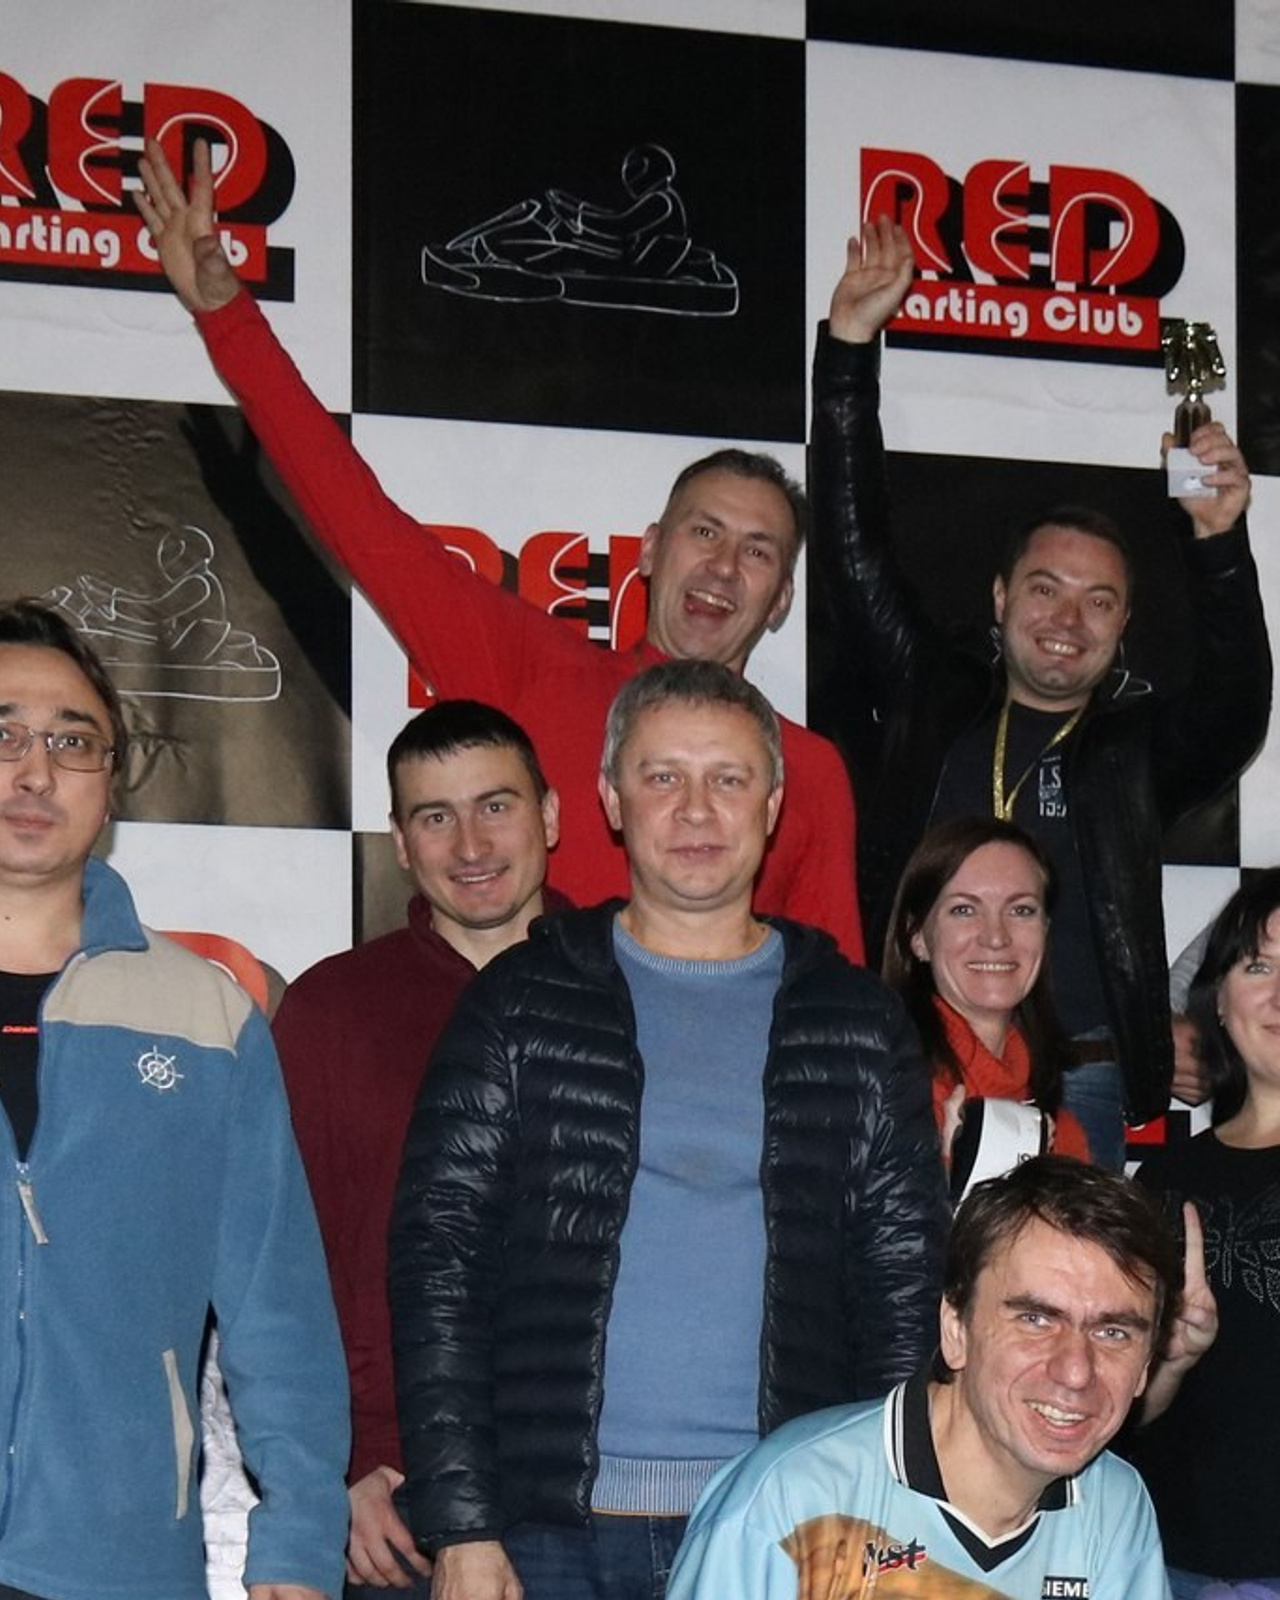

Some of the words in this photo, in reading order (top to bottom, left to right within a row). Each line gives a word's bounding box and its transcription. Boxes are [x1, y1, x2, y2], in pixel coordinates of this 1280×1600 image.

[0, 215, 121, 268] rting
[860, 147, 1161, 288] RED
[898, 289, 1029, 338] arting
[1043, 296, 1143, 336] Club
